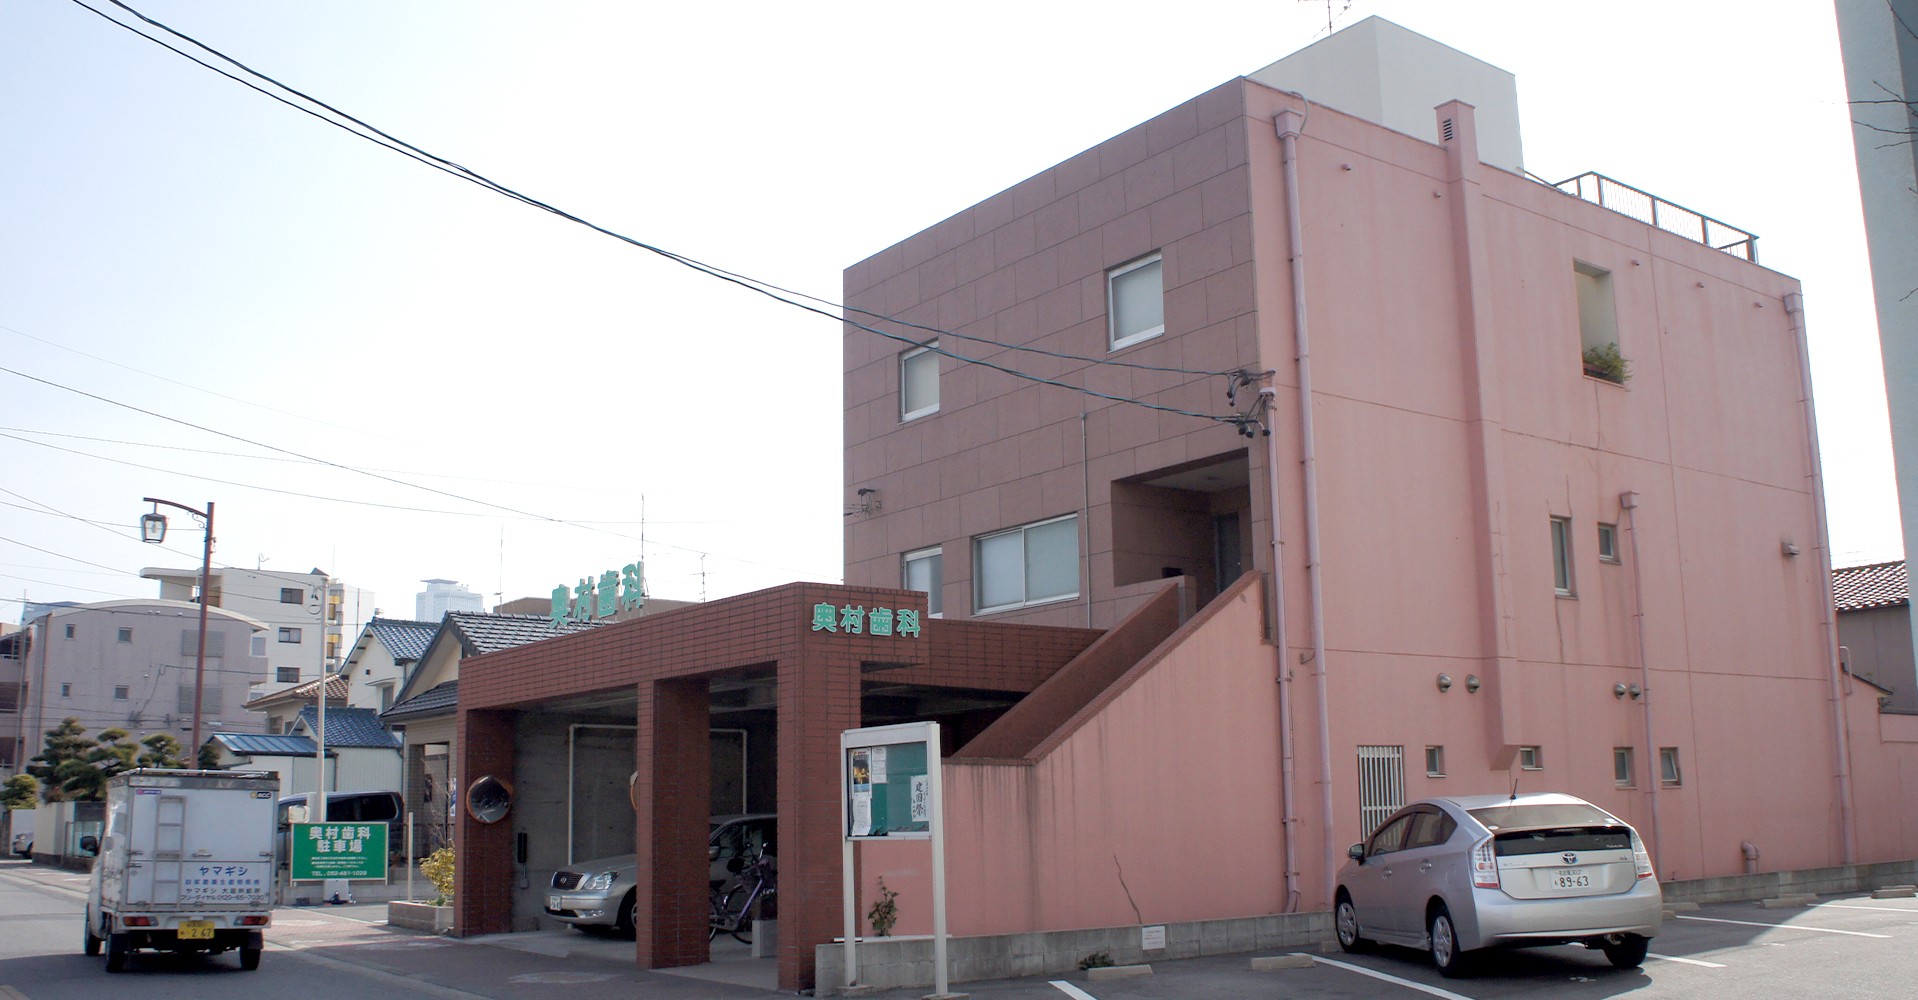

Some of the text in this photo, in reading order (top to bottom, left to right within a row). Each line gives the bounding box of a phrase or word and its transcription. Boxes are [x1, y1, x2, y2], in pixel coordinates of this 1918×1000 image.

[549, 560, 646, 629] 奥村歯科
[811, 601, 921, 639] 奥村歯科
[309, 826, 371, 840] 奥村歯科
[317, 840, 363, 853] 駐車場
[199, 865, 248, 877] ヤマギシ
[1559, 875, 1589, 888] 89-63
